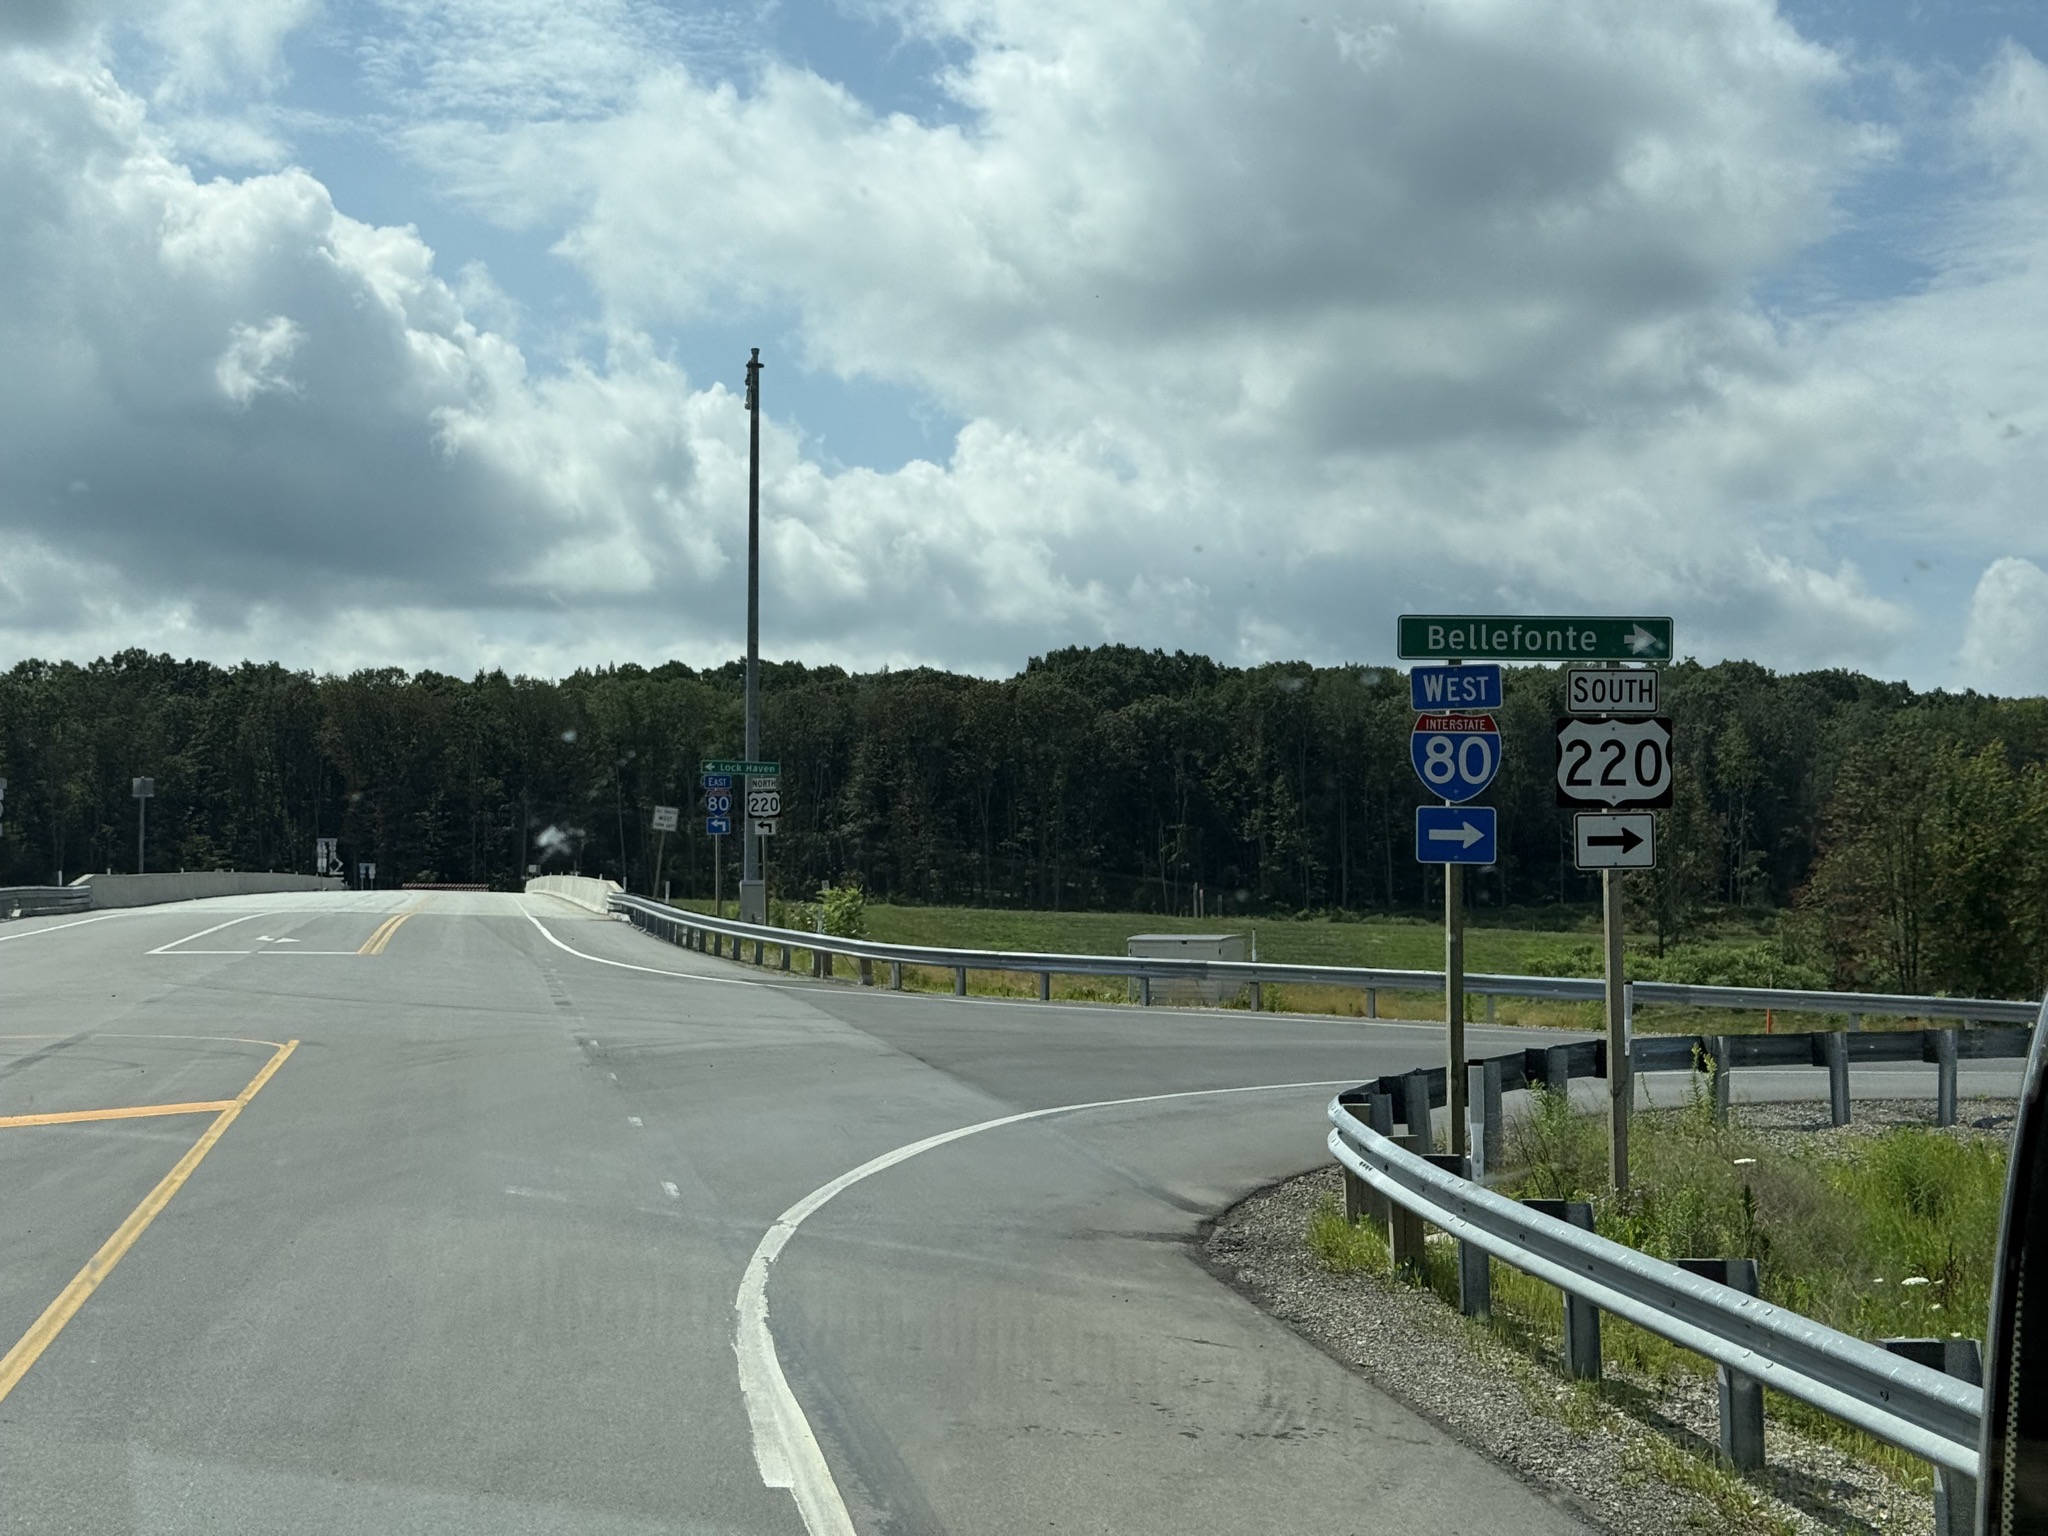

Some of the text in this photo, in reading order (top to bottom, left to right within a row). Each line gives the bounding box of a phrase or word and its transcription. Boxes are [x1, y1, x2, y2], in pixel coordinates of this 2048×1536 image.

[1428, 624, 1597, 651] Bellefonte
[1423, 674, 1489, 702] WEST
[1573, 677, 1653, 703] SOUTH
[1426, 719, 1486, 731] INTERSTATE
[720, 763, 775, 773] Lock Haven
[1424, 736, 1491, 785] 80
[1565, 739, 1662, 787] 220
[708, 777, 727, 787] EAST
[752, 780, 776, 788] NORTH
[708, 796, 729, 811] 80
[751, 797, 778, 812] 220
